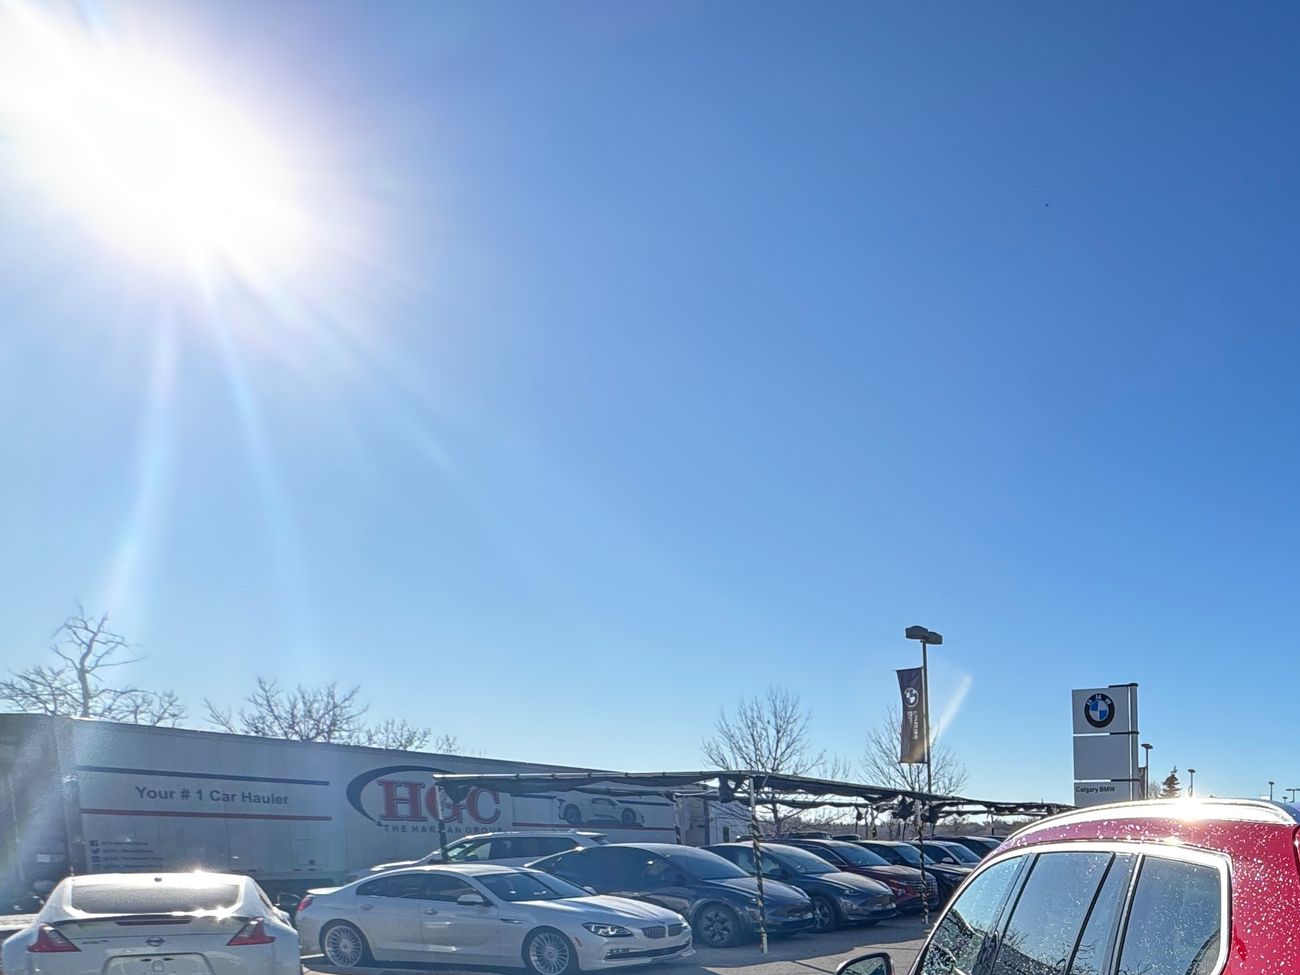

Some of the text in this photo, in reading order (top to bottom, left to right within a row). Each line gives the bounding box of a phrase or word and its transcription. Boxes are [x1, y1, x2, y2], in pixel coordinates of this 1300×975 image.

[135, 786, 289, 805] Your # 1 Car Hauler
[1075, 786, 1098, 794] Calgary
[377, 780, 501, 824] HGC
[383, 825, 408, 833] THE
[412, 825, 462, 833] HARAN
